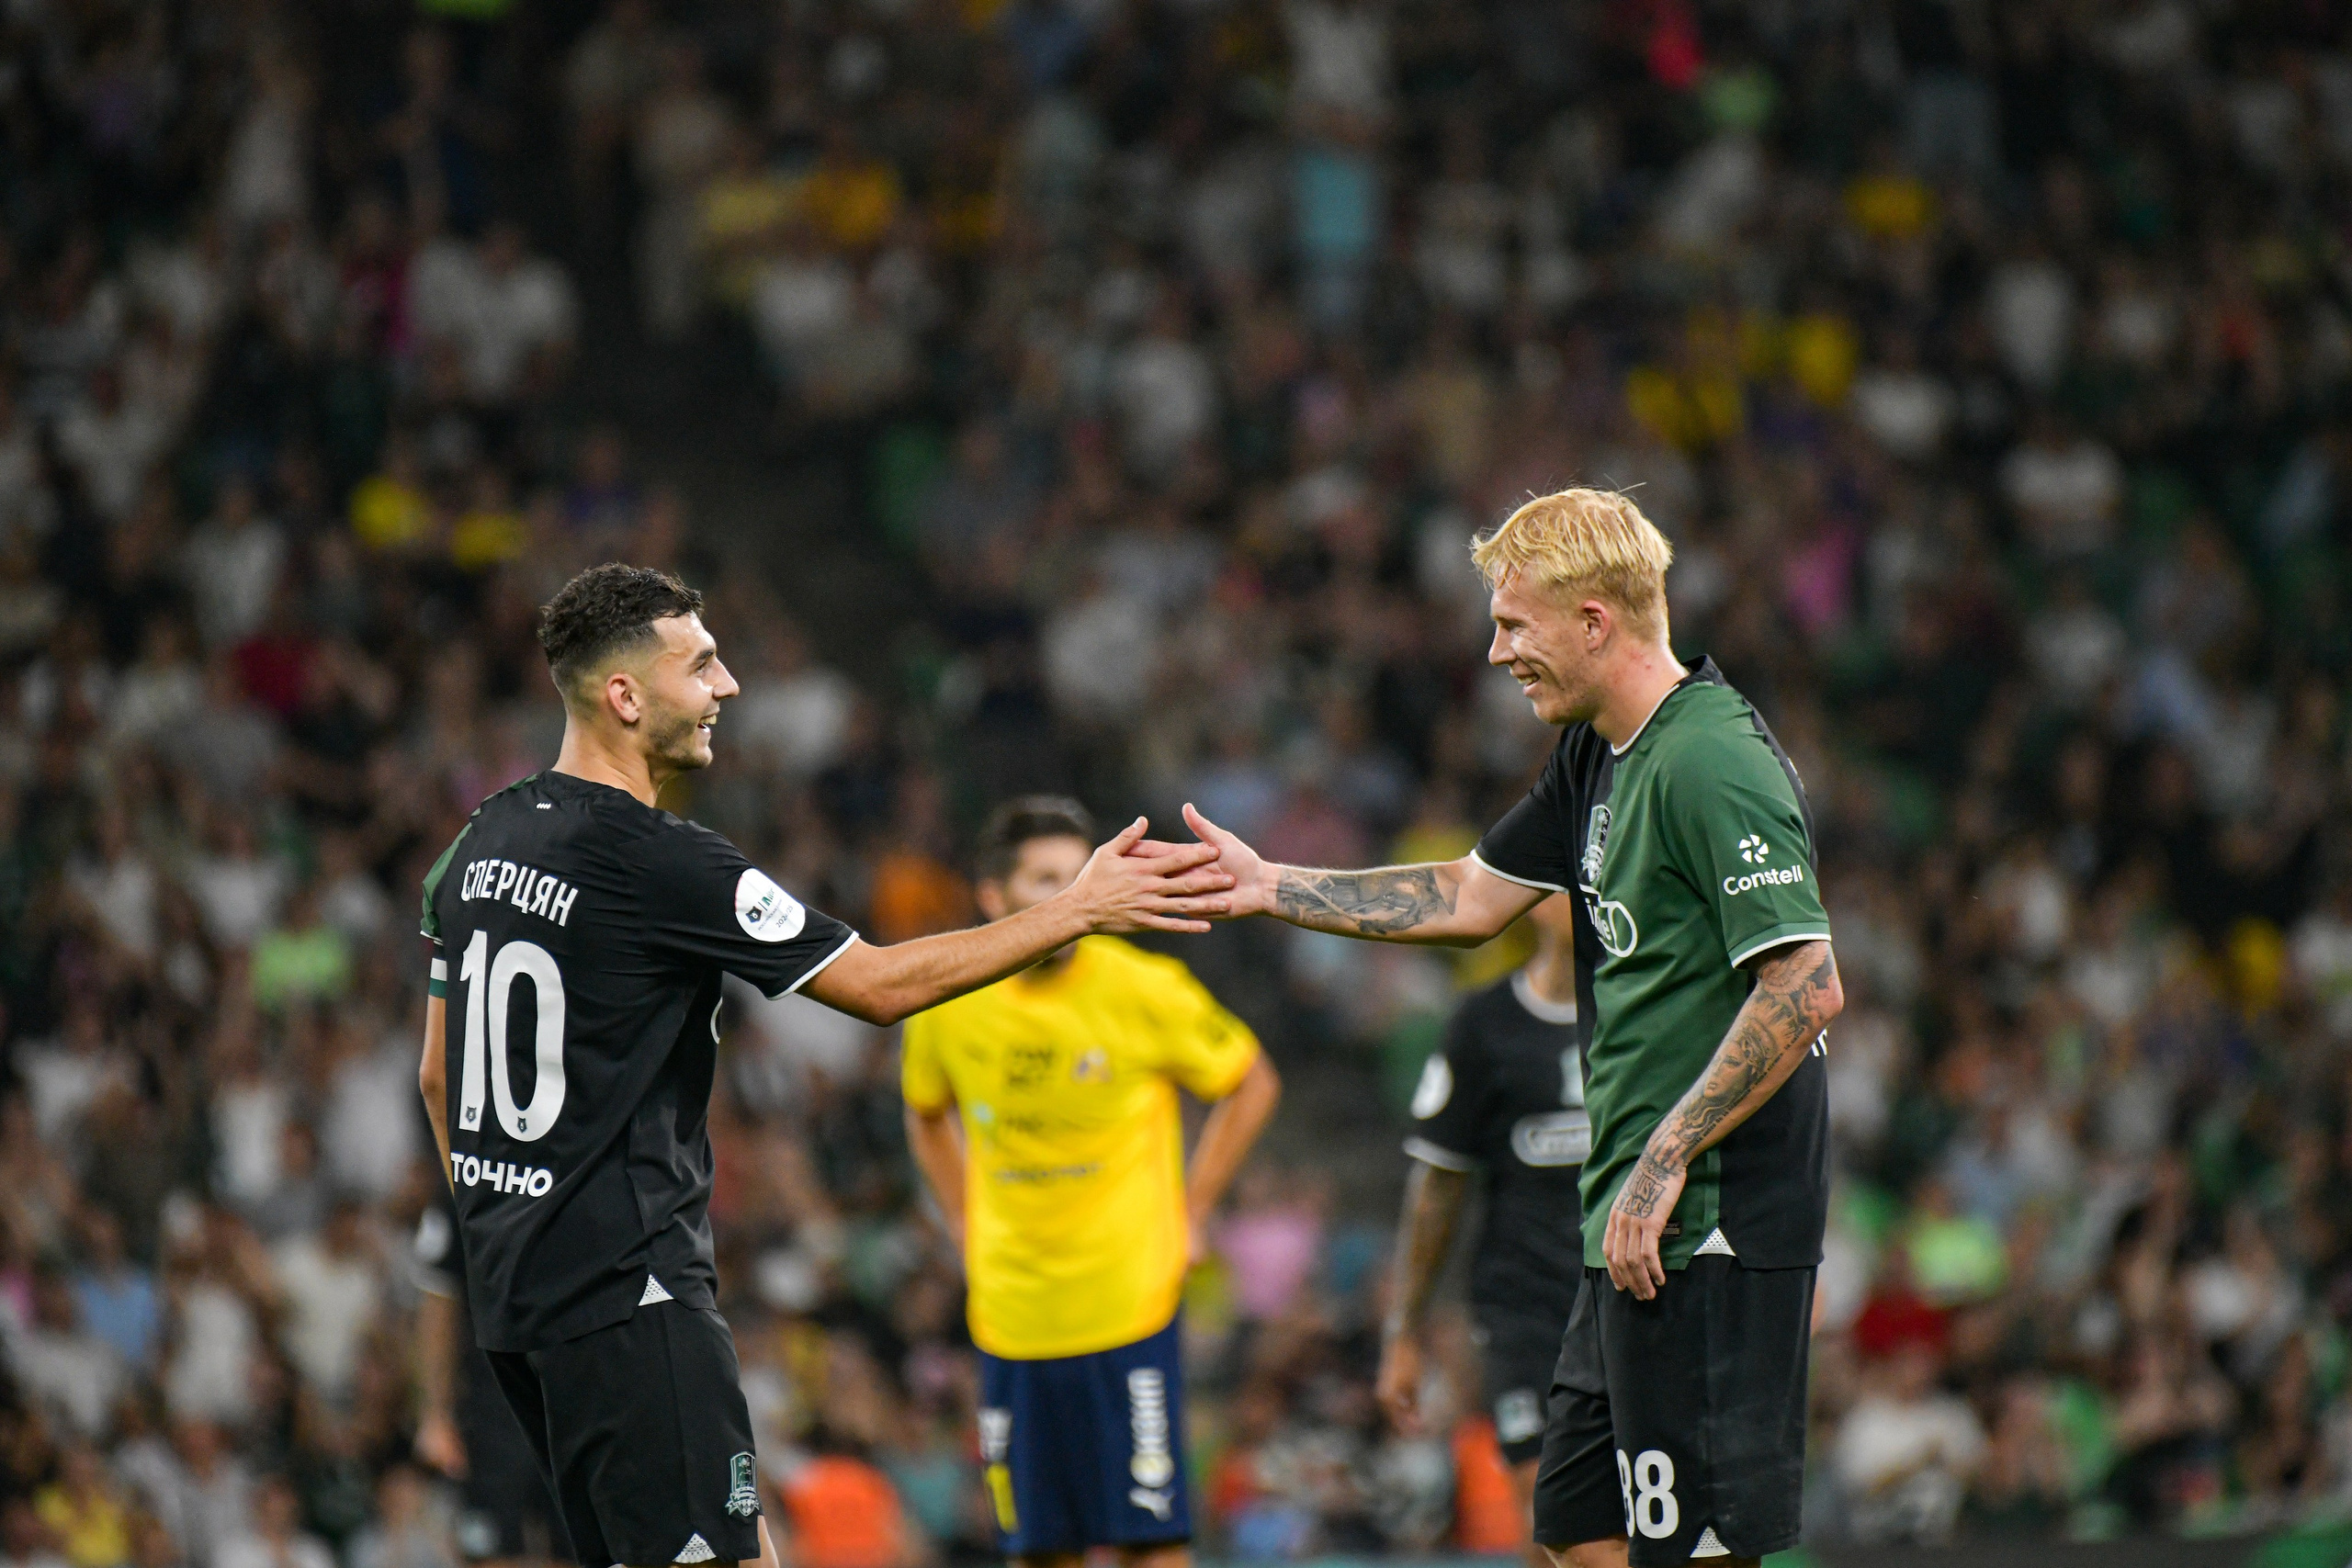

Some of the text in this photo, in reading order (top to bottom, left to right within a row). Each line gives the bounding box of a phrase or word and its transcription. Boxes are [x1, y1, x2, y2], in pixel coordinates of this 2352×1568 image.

[461, 859, 579, 927] СПЕРЦЯН
[1723, 864, 1803, 896] Constell
[459, 929, 566, 1142] 10
[450, 1152, 553, 1198] ТОЧНО
